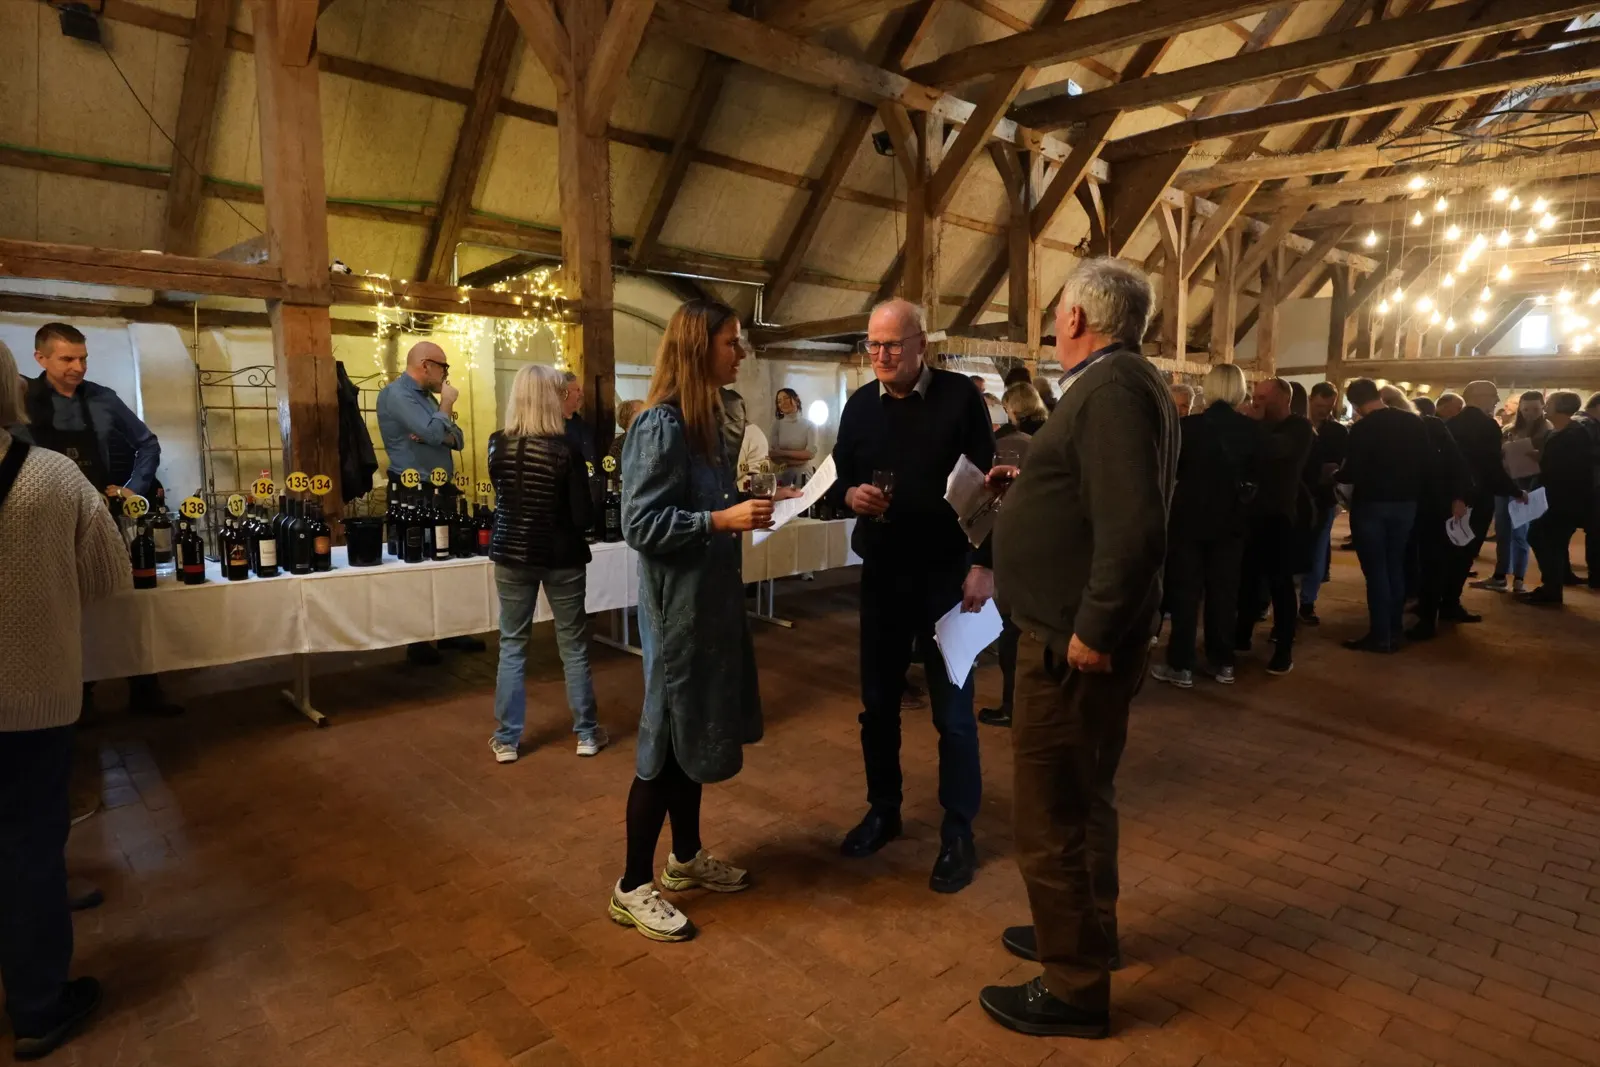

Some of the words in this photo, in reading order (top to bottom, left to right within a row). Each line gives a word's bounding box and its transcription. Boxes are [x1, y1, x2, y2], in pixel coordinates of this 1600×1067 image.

[287, 477, 309, 488] 135
[402, 473, 420, 483] 133
[431, 472, 447, 482] 132
[455, 476, 470, 487] 131
[252, 482, 274, 495] 136
[309, 479, 331, 490] 134
[476, 482, 492, 493] 130
[123, 499, 147, 516] 139
[181, 502, 204, 514] 138
[228, 499, 243, 512] 137
